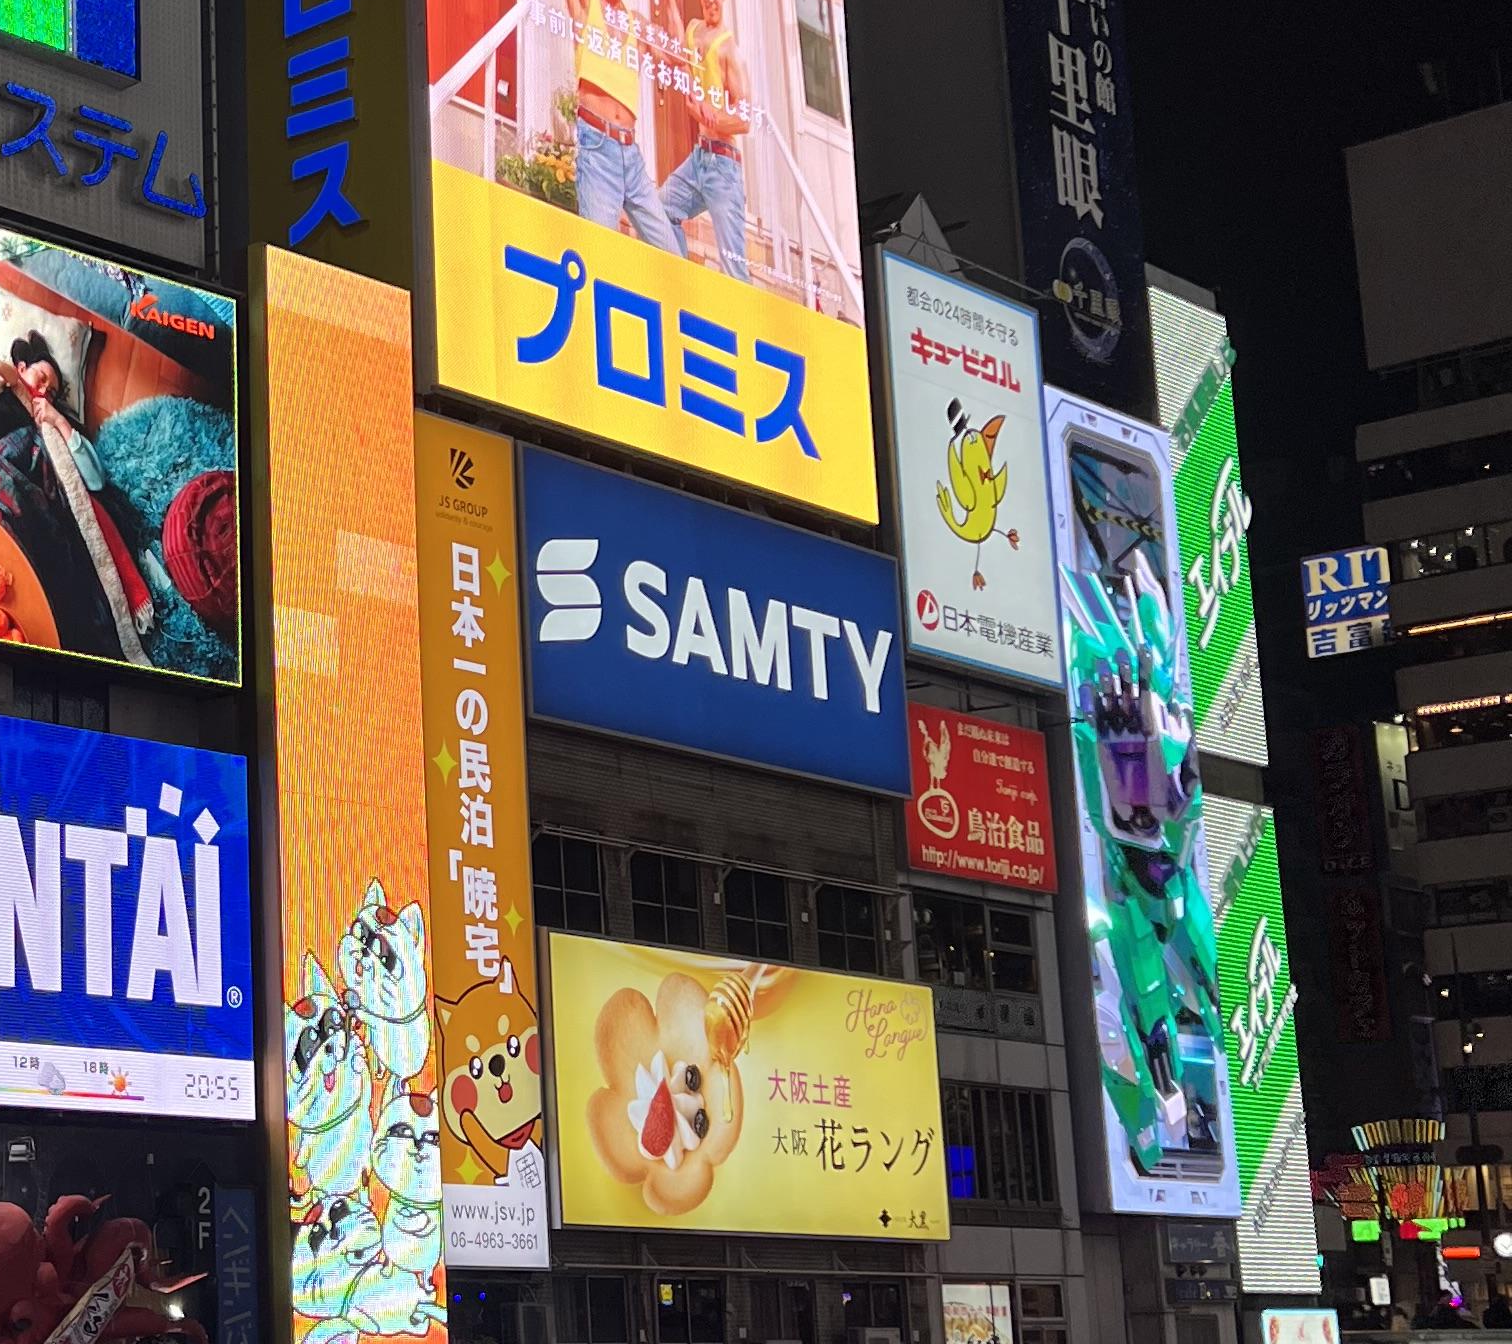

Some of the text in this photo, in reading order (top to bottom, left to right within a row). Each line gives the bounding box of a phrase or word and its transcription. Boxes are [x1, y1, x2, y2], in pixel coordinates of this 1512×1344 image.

[604, 4, 702, 65] お客さまサポート
[130, 293, 216, 340] KAIGEN
[906, 286, 1019, 347] 都会の24時間を守る
[504, 244, 822, 462] プロミス
[909, 327, 1022, 394] キュービクル
[453, 498, 488, 518] GROUP
[623, 559, 893, 713] SAMTY
[943, 604, 1055, 659] 日本電機産業
[185, 1073, 240, 1101] 20:55
[768, 1069, 853, 1109] 大阪土産
[771, 1118, 935, 1176] 大阪 花ラング
[451, 1203, 535, 1224] www.jsv.jp
[451, 1231, 539, 1251] 06-4963-3661
